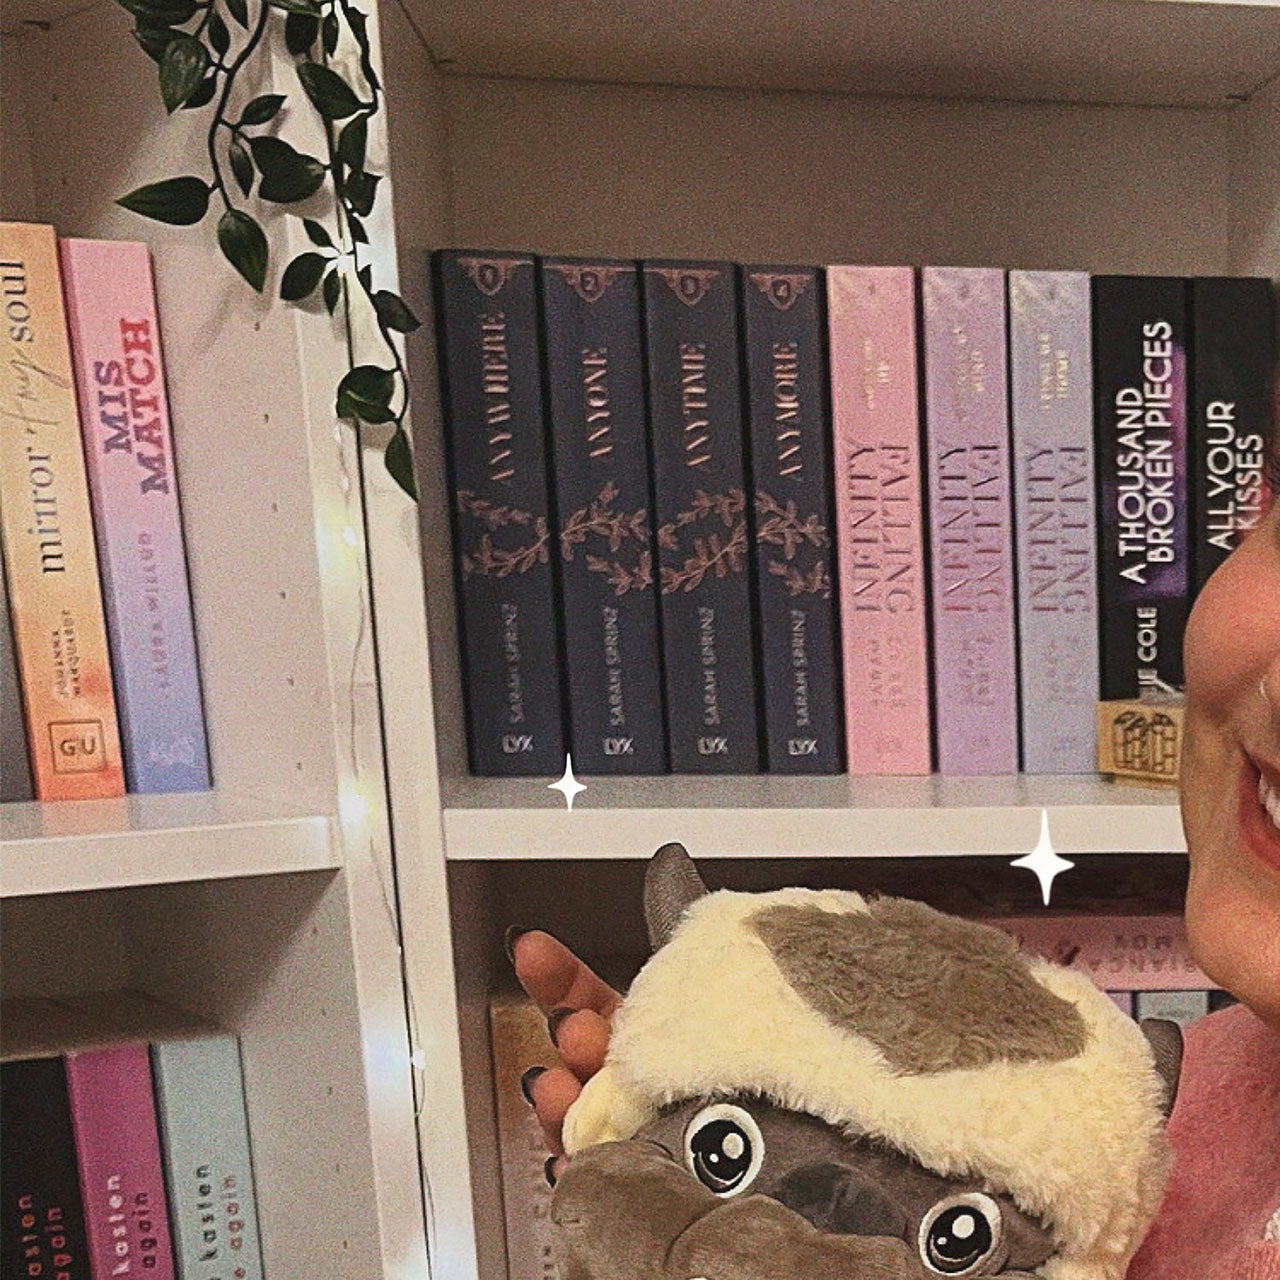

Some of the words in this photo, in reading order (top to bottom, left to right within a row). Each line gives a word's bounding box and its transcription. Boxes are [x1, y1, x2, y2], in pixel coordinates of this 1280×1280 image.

[0, 262, 33, 344] soul
[93, 359, 134, 455] MIS
[119, 317, 170, 496] MATCH
[478, 311, 515, 485] ANYWHERE
[582, 346, 614, 464] ANYONE
[680, 342, 713, 473] ANYTIME
[772, 341, 804, 482] ANYMORE
[1142, 320, 1173, 428] PIECES
[1116, 387, 1146, 558] THOUSAND
[1144, 438, 1175, 563] BROKEN
[1206, 400, 1236, 499] YOUR
[1236, 433, 1264, 532] KISSES
[27, 445, 66, 575] mirror
[847, 437, 881, 613] INFINITY
[880, 444, 914, 615] FALLING
[938, 439, 973, 612] INFINITY
[971, 443, 1002, 615] FALLING
[1025, 441, 1059, 612] INFINITY
[1059, 444, 1091, 615] FALLING
[1206, 500, 1236, 551] ALL
[1119, 563, 1147, 584] A
[1136, 606, 1159, 661] COLE
[59, 737, 97, 757] GU
[503, 735, 533, 755] LYX
[604, 737, 634, 757] LYX
[698, 737, 729, 757] LYX
[788, 737, 819, 757] LYX
[106, 1174, 131, 1277] kasten
[132, 1192, 158, 1269] again
[195, 1164, 218, 1262] kasten
[219, 1174, 245, 1251] again
